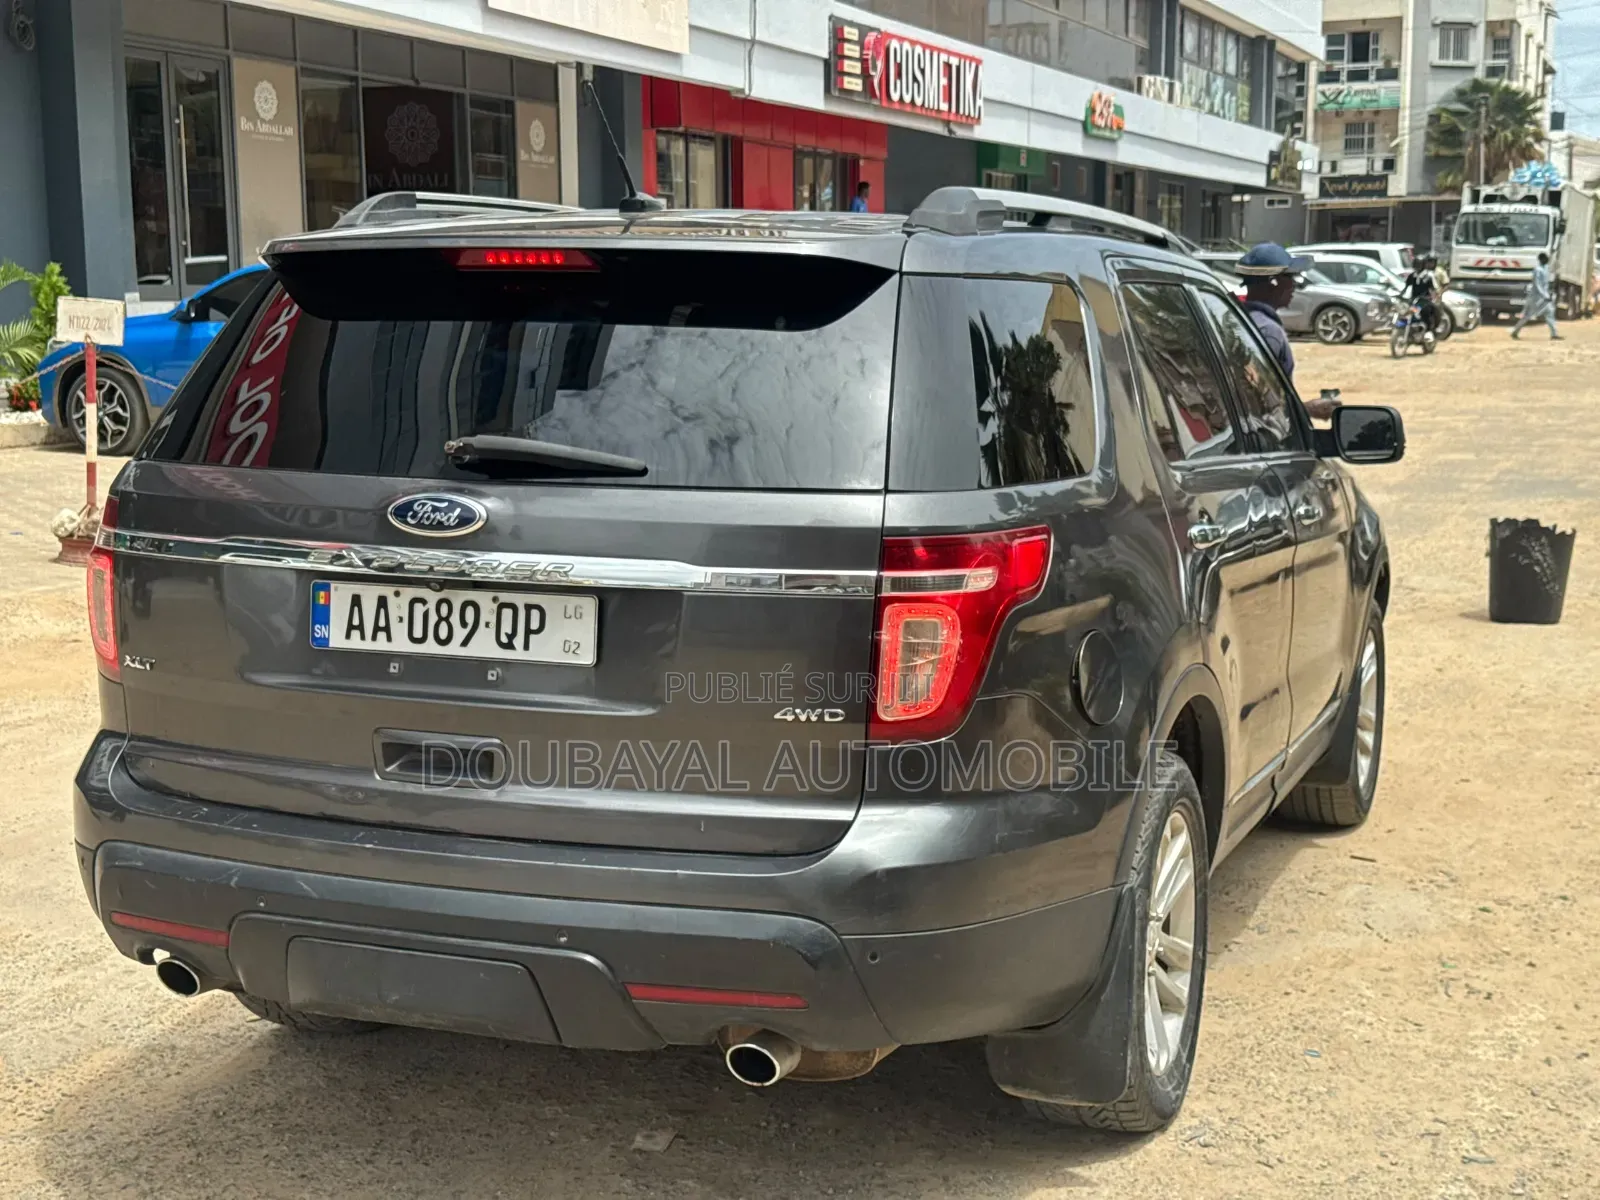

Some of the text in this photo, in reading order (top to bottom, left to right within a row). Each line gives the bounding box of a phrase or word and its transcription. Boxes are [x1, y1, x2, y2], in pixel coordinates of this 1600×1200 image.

[888, 38, 985, 120] COSMETIKA
[406, 499, 460, 527] Ford
[307, 549, 575, 577] EXPLORER
[314, 624, 329, 638] SN
[562, 639, 581, 655] 02
[124, 654, 156, 671] XLT
[773, 707, 846, 722] 4WD
